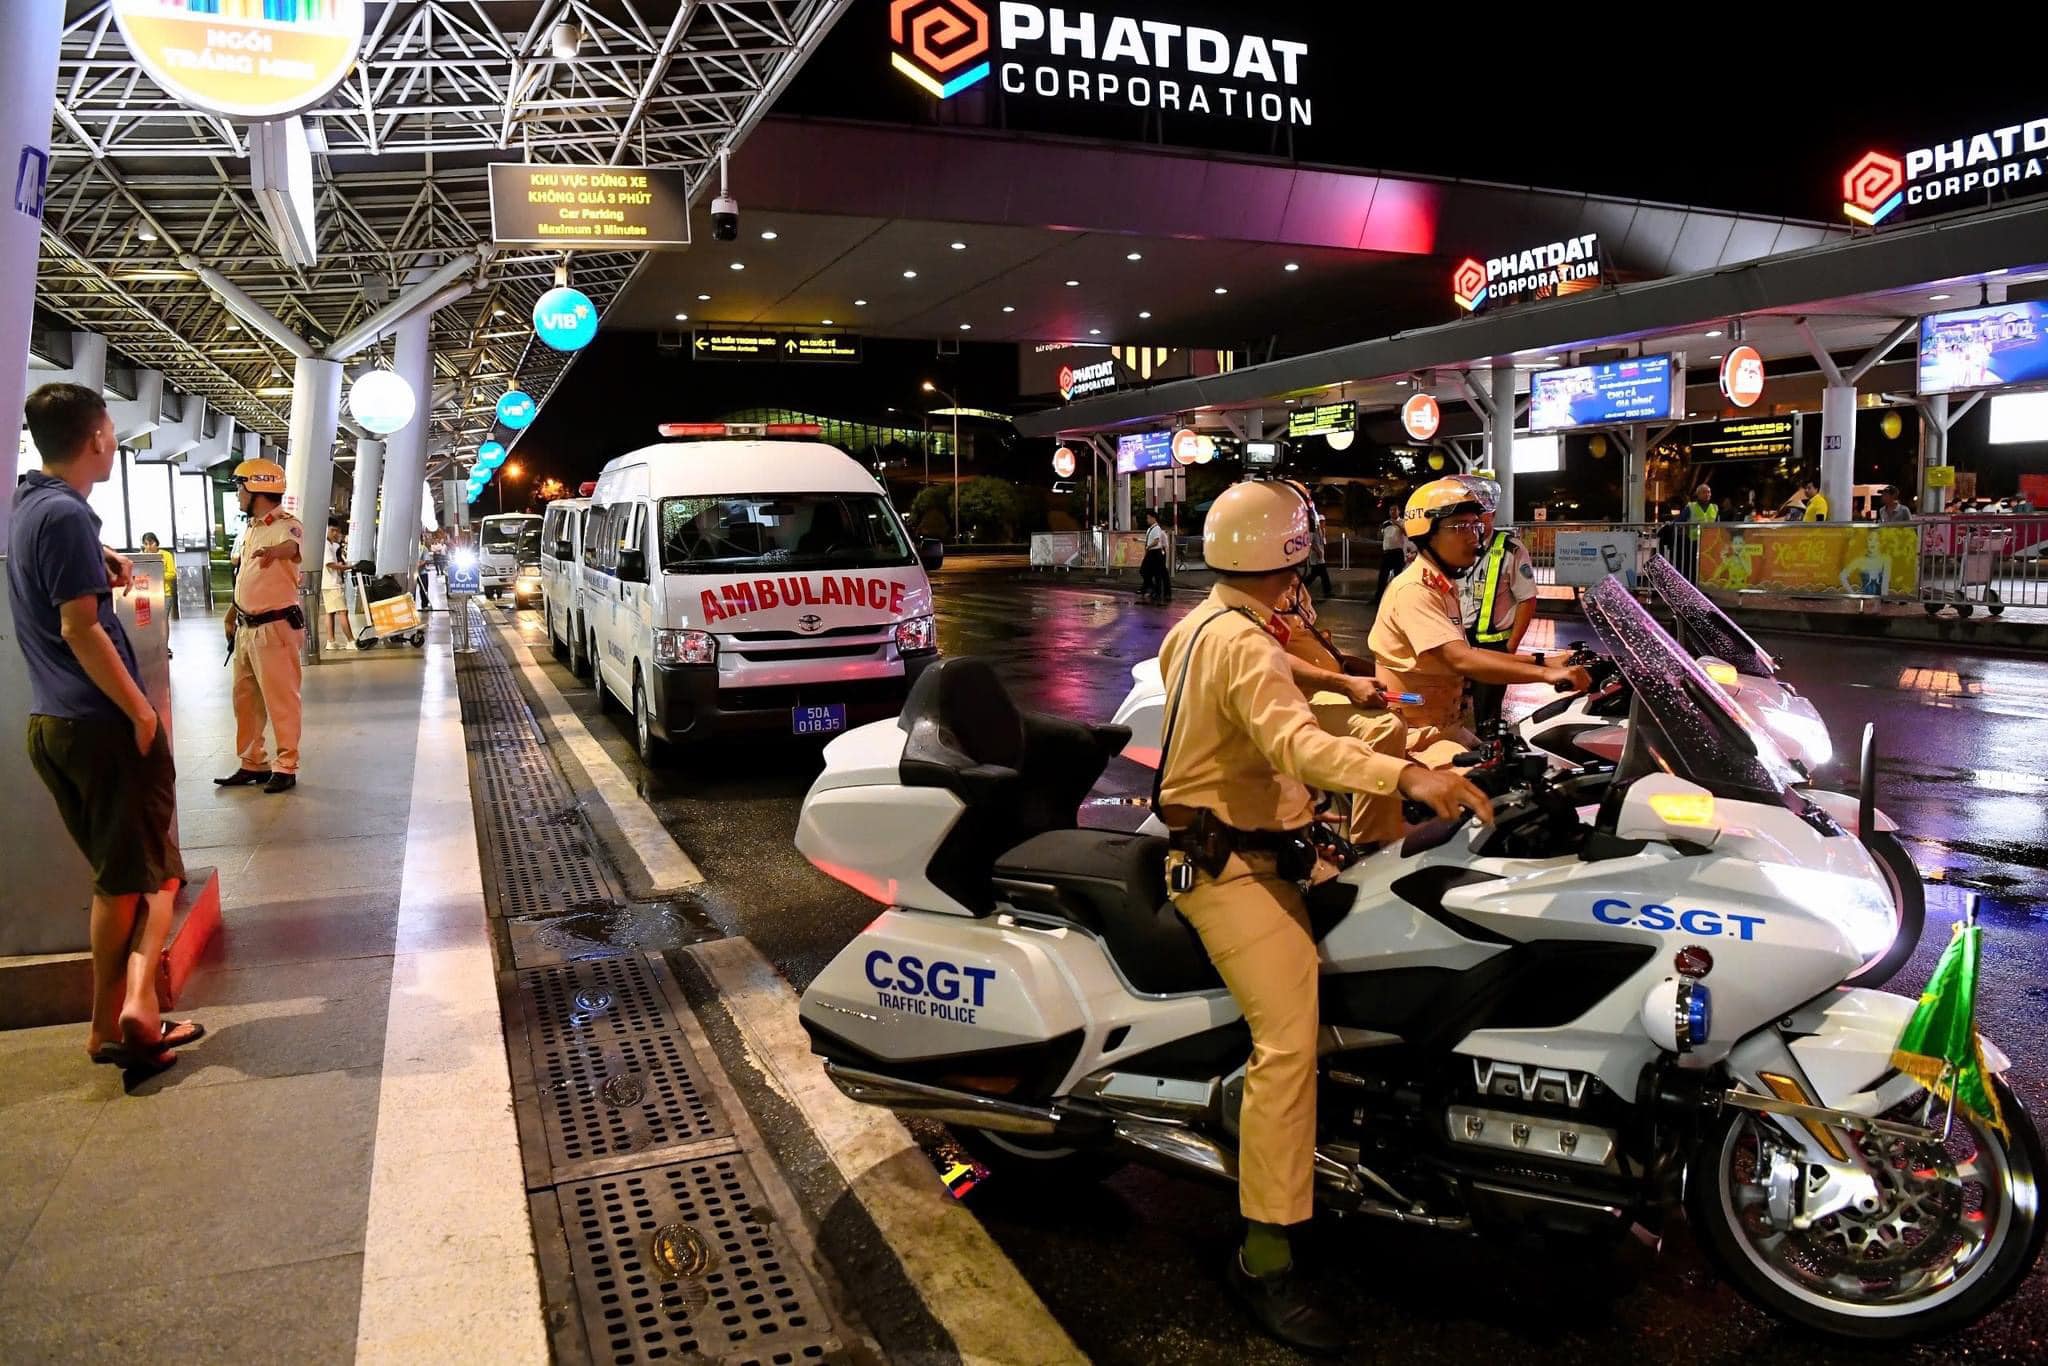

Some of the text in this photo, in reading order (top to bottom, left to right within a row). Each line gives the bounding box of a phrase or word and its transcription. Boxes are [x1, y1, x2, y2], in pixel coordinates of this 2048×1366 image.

[1000, 2, 1308, 85] PHATDAT
[1001, 62, 1312, 126] CORPORATION
[530, 173, 648, 189] KHU VỰC DỪNG XE
[1907, 156, 2048, 205] CORPORA
[528, 190, 653, 205] KHÔNG QUÁ 3 PHÚT
[559, 208, 624, 222] Car Parking
[538, 224, 648, 236] Maximum 3 Minutes
[1486, 233, 1597, 282] PHATDAT
[1489, 261, 1600, 299] CORPORATION
[541, 312, 577, 330] VIB
[1072, 360, 1114, 384] PHATDAT
[1073, 376, 1116, 395] CORPORATION
[700, 576, 906, 625] AMBULANCE
[799, 718, 840, 732] 018.35
[807, 706, 831, 719] 50A
[1592, 898, 1766, 941] C.S.G.T
[865, 950, 996, 1007] C.S.G.T
[877, 991, 927, 1016] TRAFFIC
[930, 1001, 977, 1025] POLICE
